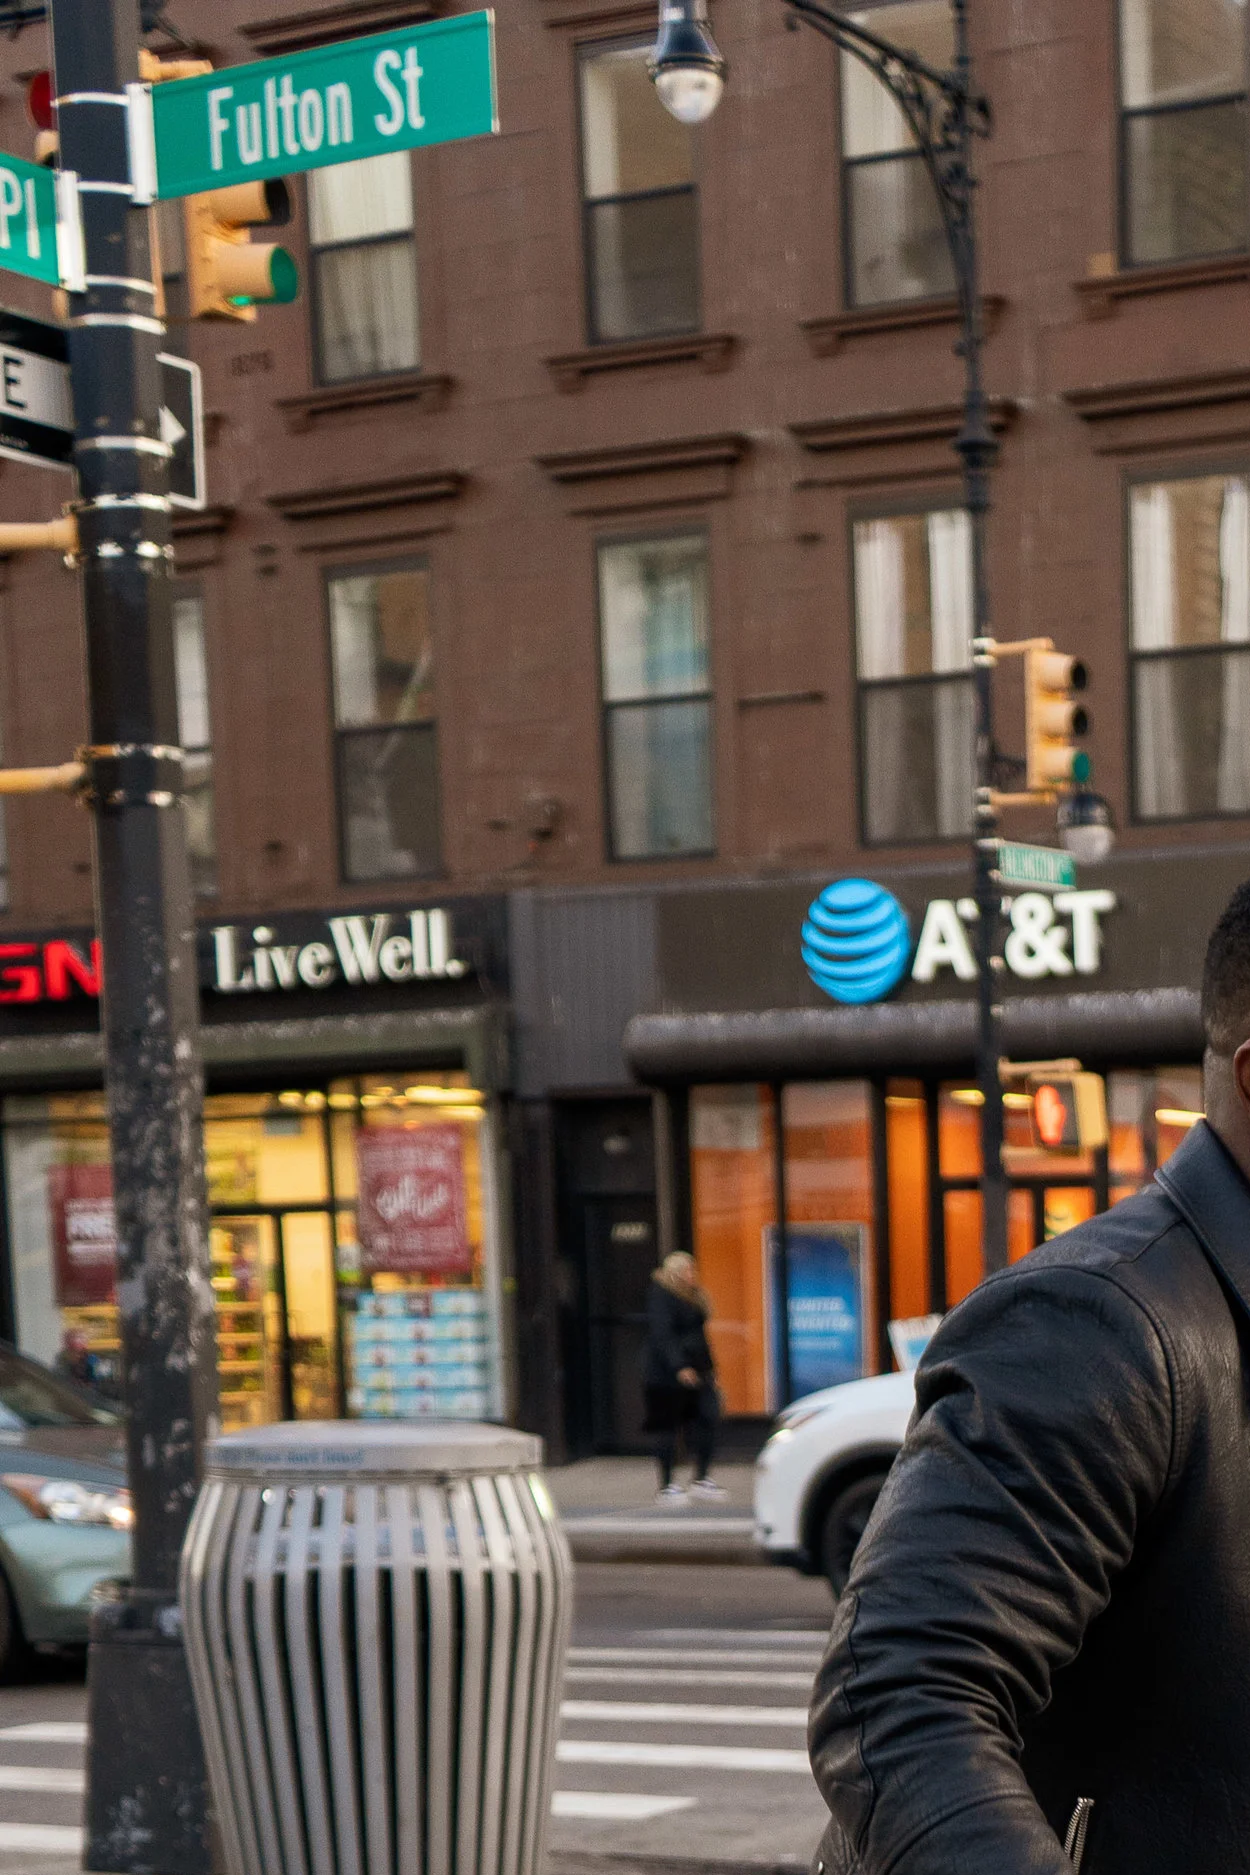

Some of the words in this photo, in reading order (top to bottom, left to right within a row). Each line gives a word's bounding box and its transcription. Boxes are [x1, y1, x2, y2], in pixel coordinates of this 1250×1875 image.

[207, 74, 354, 171] Fulton
[374, 46, 425, 137] St
[0, 939, 102, 1001] GN
